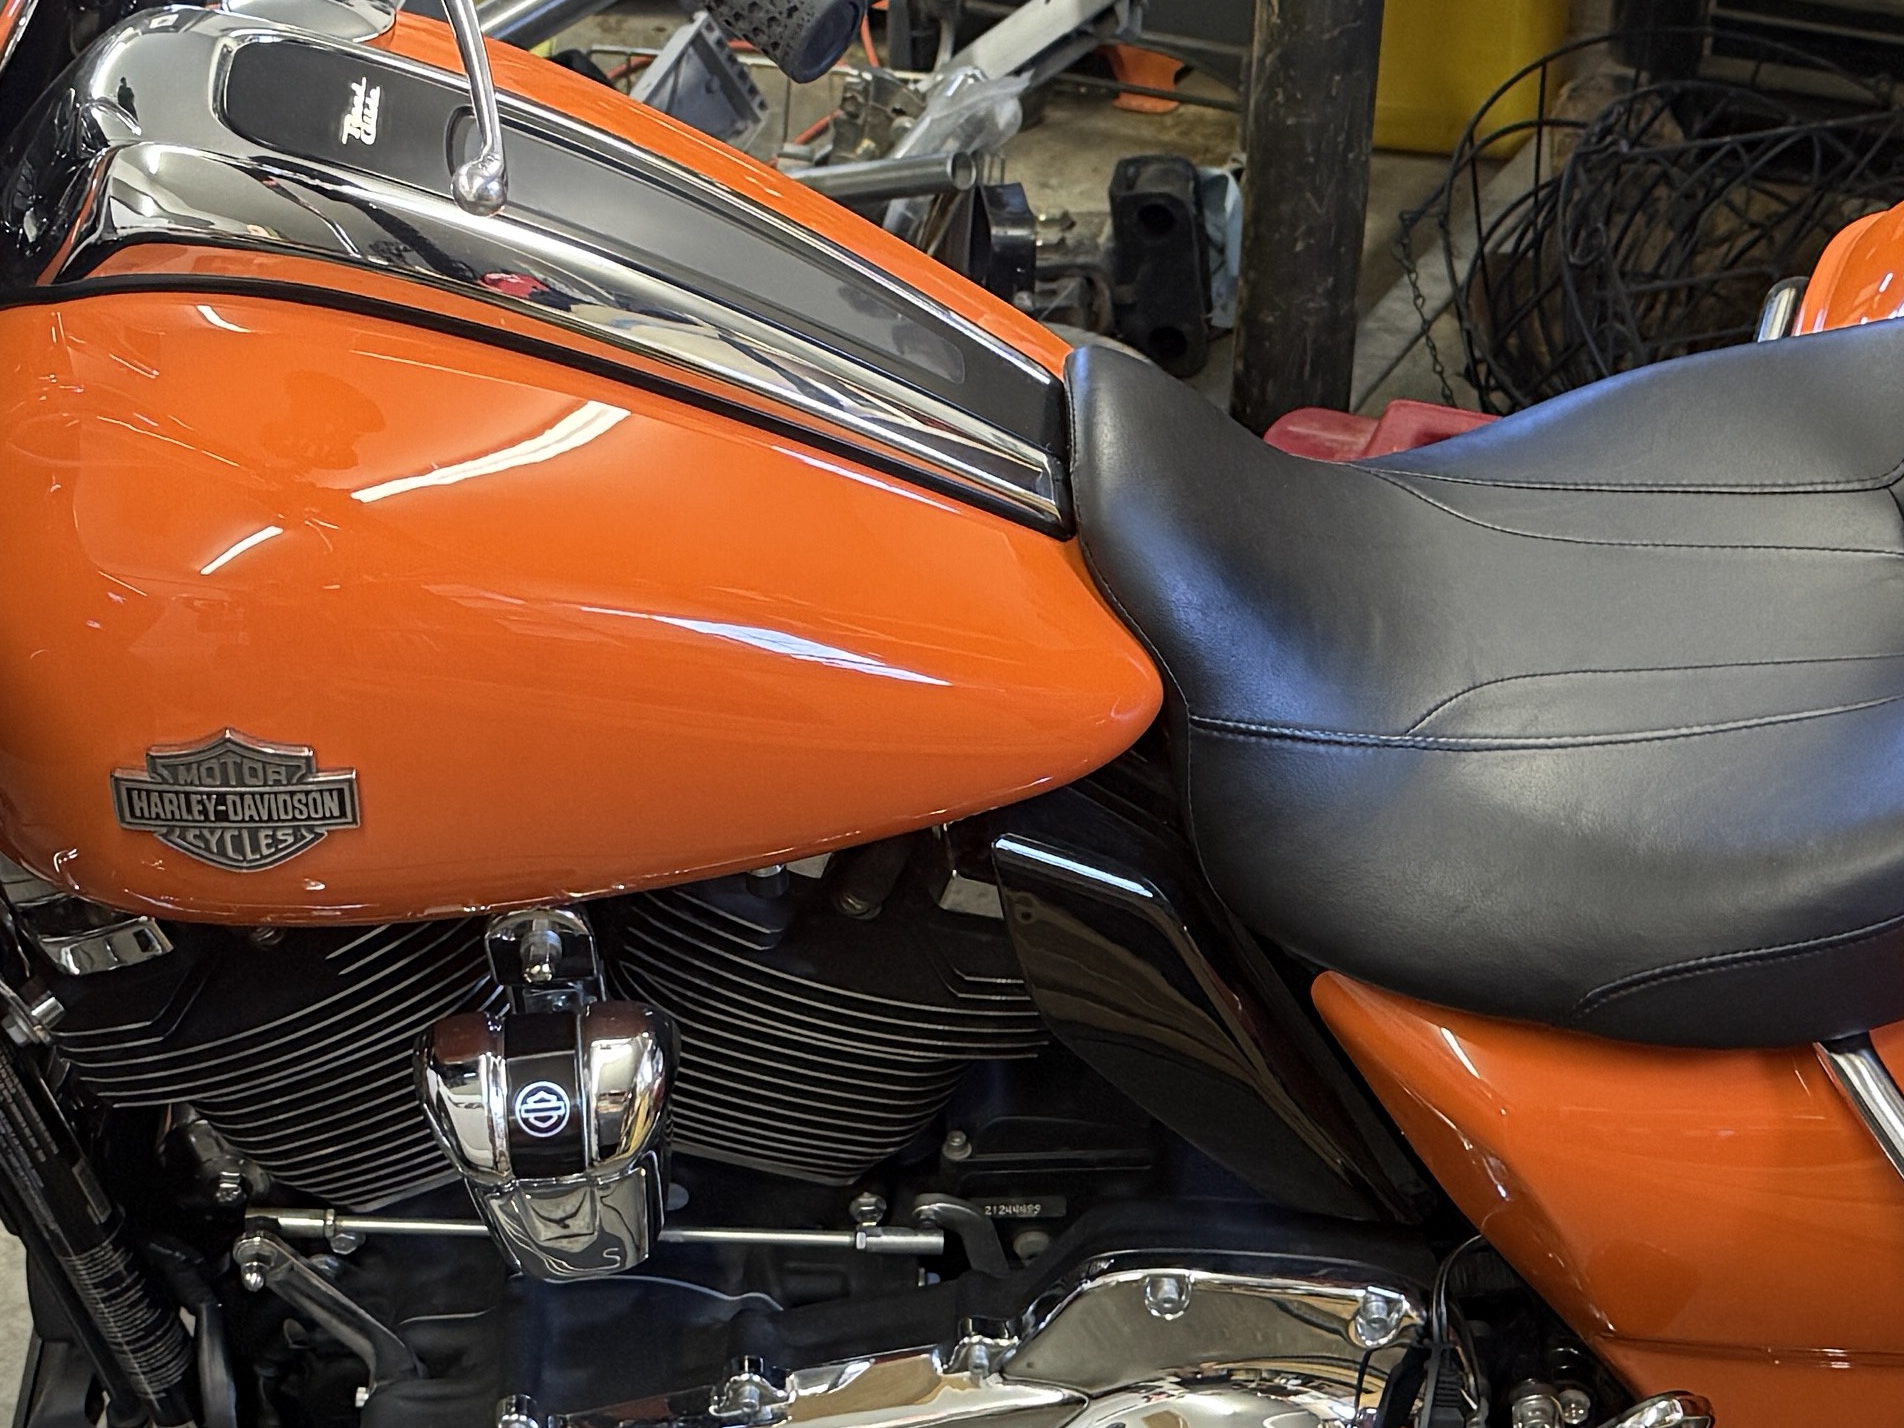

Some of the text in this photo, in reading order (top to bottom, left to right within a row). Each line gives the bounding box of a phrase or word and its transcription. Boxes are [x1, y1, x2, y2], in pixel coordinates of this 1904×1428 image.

[180, 756, 287, 786] MOTOR
[130, 789, 340, 823] HARLEY-DAVIDSON
[188, 828, 295, 861] CYCLES
